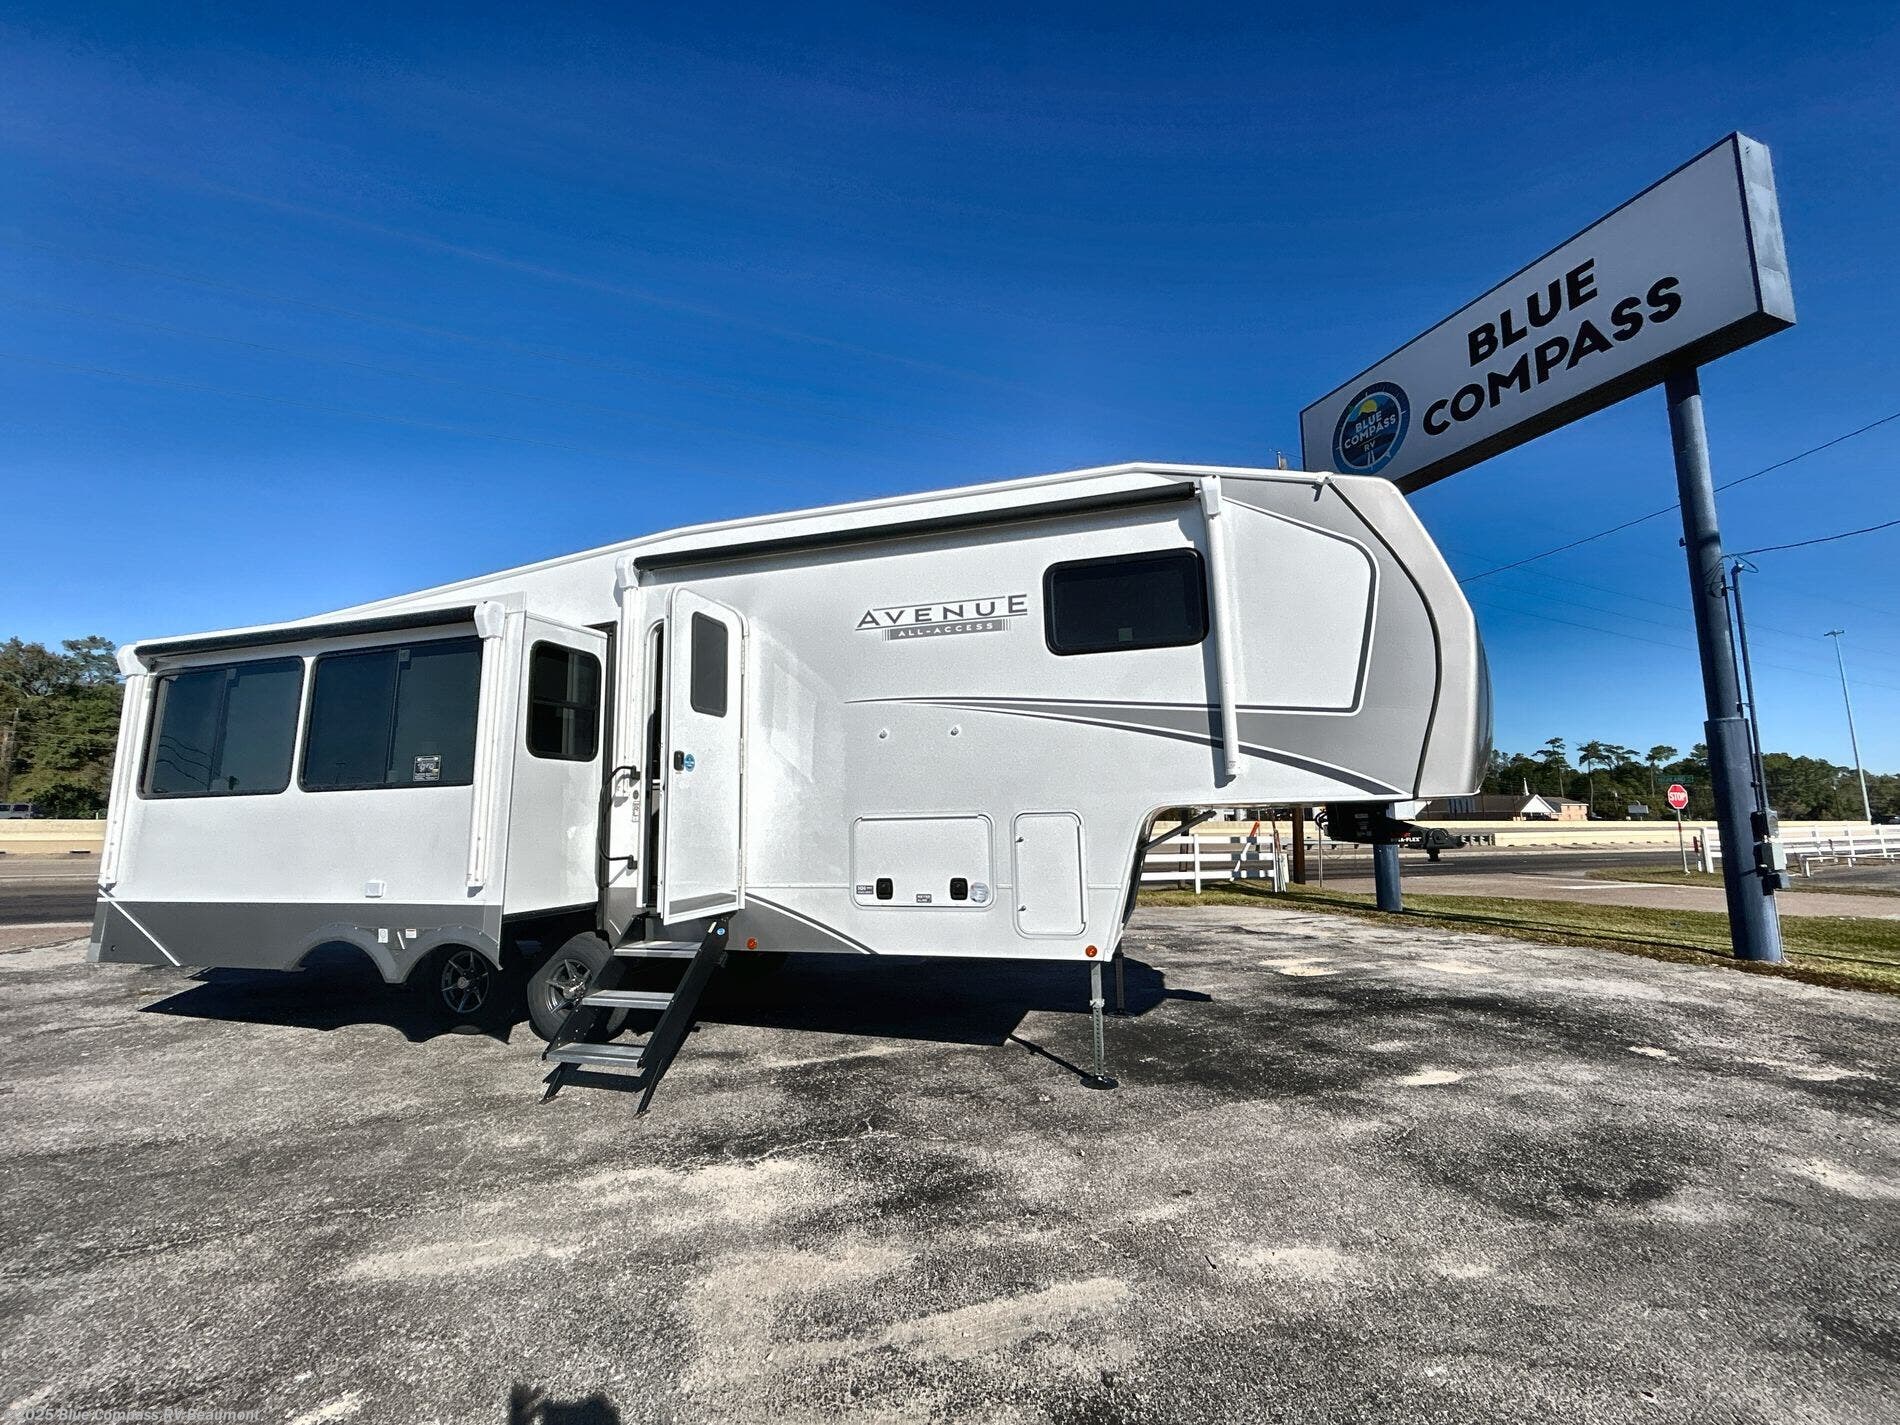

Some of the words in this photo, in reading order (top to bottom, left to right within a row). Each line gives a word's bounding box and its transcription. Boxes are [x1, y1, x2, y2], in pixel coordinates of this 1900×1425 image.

[1468, 258, 1598, 368] BLUE
[1422, 276, 1683, 436] COMPASS
[1344, 414, 1396, 449] COMPASS
[1355, 410, 1382, 433] BLUE
[1364, 440, 1375, 452] RV
[857, 594, 1028, 628] AVENUE
[898, 622, 994, 637] ALL-ACCESS
[1669, 792, 1687, 801] STOP
